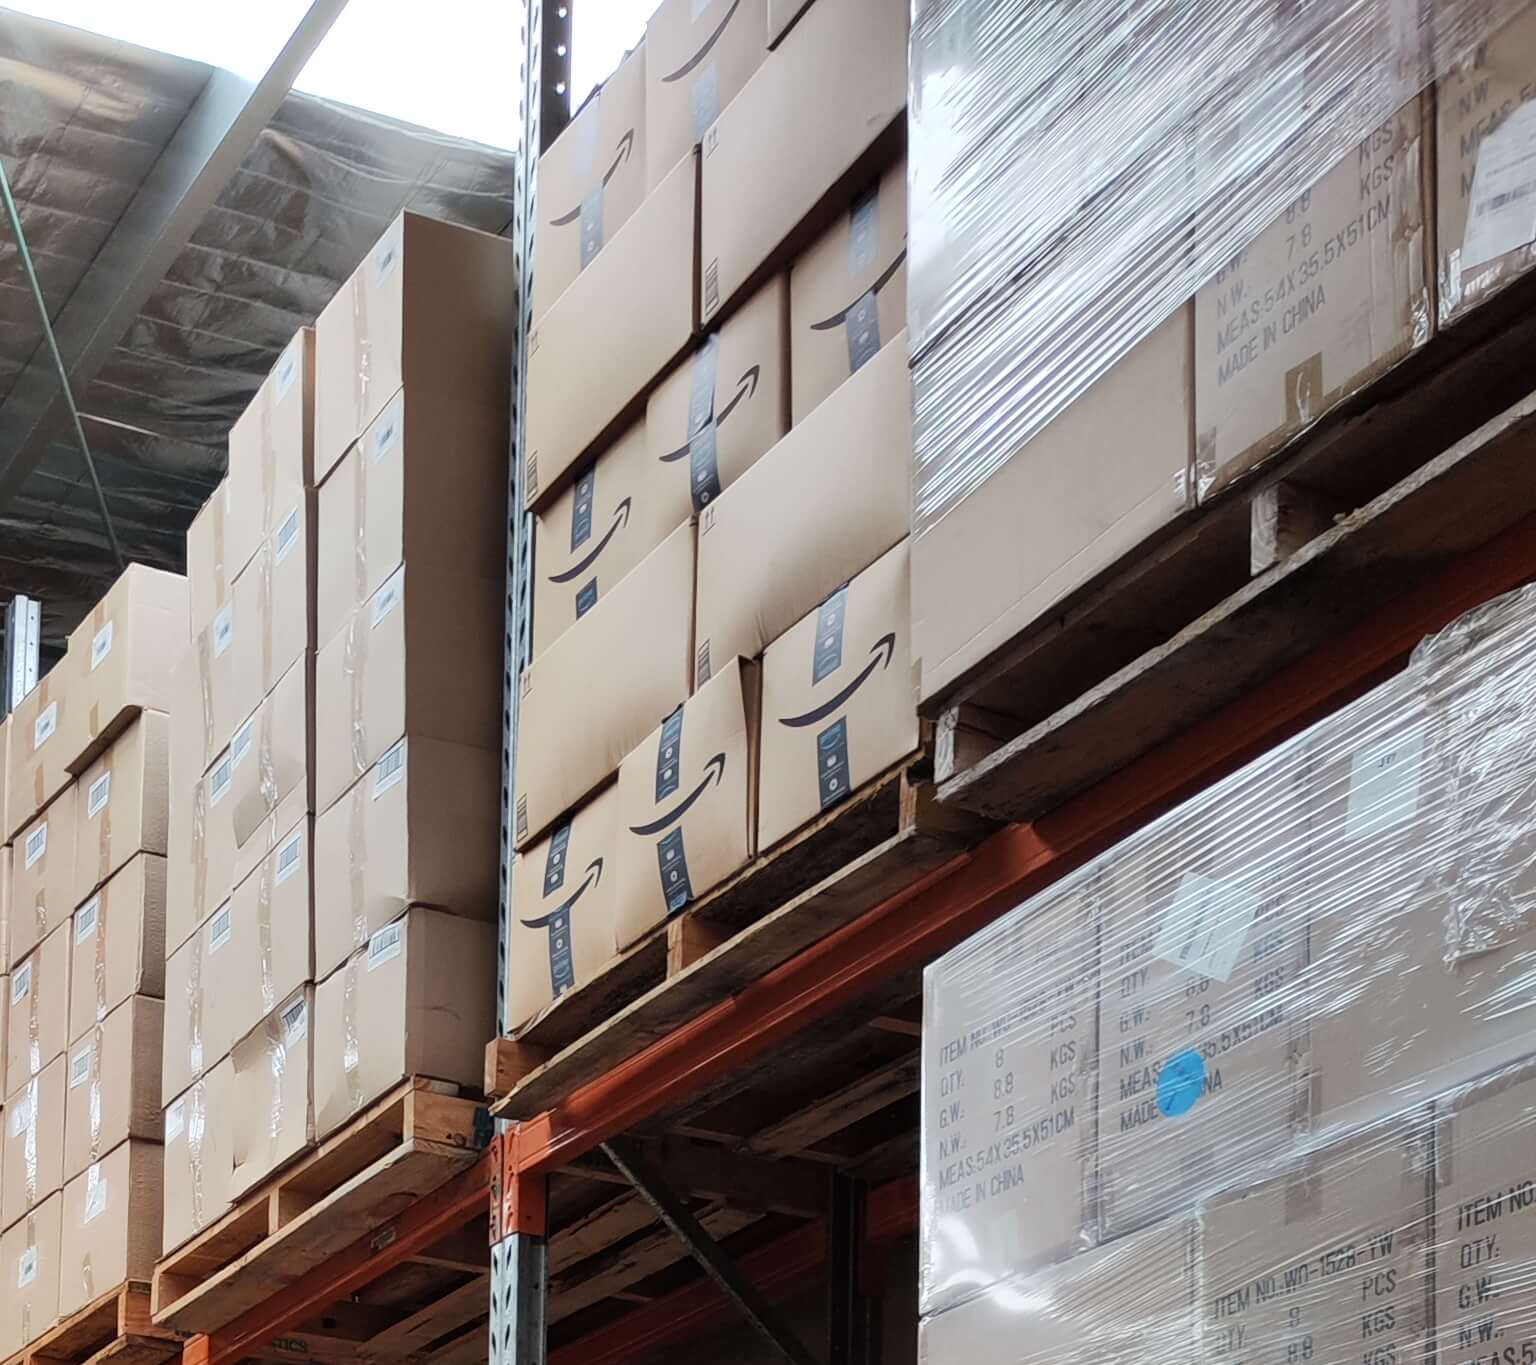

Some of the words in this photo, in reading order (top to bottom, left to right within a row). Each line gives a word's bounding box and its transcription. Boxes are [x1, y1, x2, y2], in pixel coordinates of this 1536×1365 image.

[1360, 154, 1394, 200] KGS
[1219, 335, 1258, 387] MADE
[1264, 320, 1278, 347] IN
[1282, 283, 1327, 335] CHINA
[1049, 1040, 1077, 1071] KGS
[993, 1072, 1014, 1100] 8.8
[1050, 1073, 1076, 1104] KGS
[993, 1105, 1014, 1132] 7.8
[975, 1180, 987, 1200] IN
[990, 1164, 1025, 1197] CHINA
[1457, 1191, 1502, 1231] ITEM
[1361, 1268, 1397, 1301] PCS
[1214, 1287, 1250, 1320] ITEM
[1361, 1305, 1397, 1339] KGS
